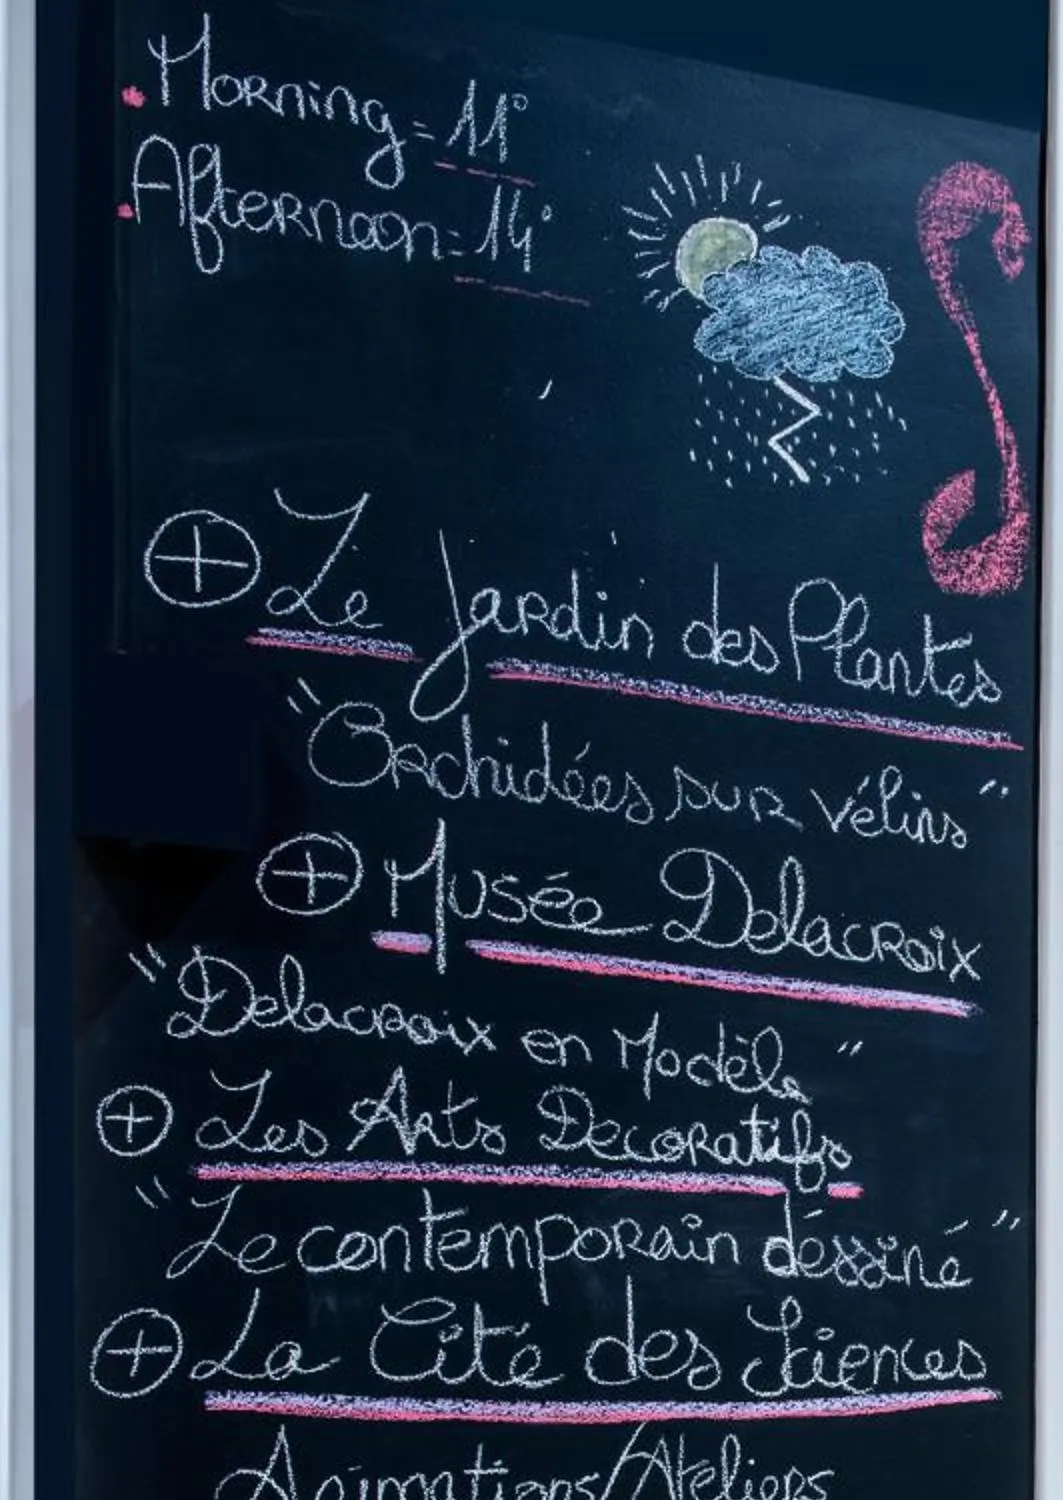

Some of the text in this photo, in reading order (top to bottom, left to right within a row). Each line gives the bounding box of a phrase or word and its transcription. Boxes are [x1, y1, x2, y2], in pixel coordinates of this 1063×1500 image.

[265, 488, 384, 629] Le
[682, 562, 781, 674] des
[788, 577, 1003, 709] Plantes
[383, 819, 982, 981] Musée Delacroix
[520, 1027, 592, 1067] en
[195, 1069, 329, 1157] Les
[347, 1066, 507, 1157] Arts
[297, 1187, 741, 1306] contemporain
[190, 1286, 341, 1382] La
[369, 1297, 567, 1390] Cité
[585, 1274, 723, 1390] des
